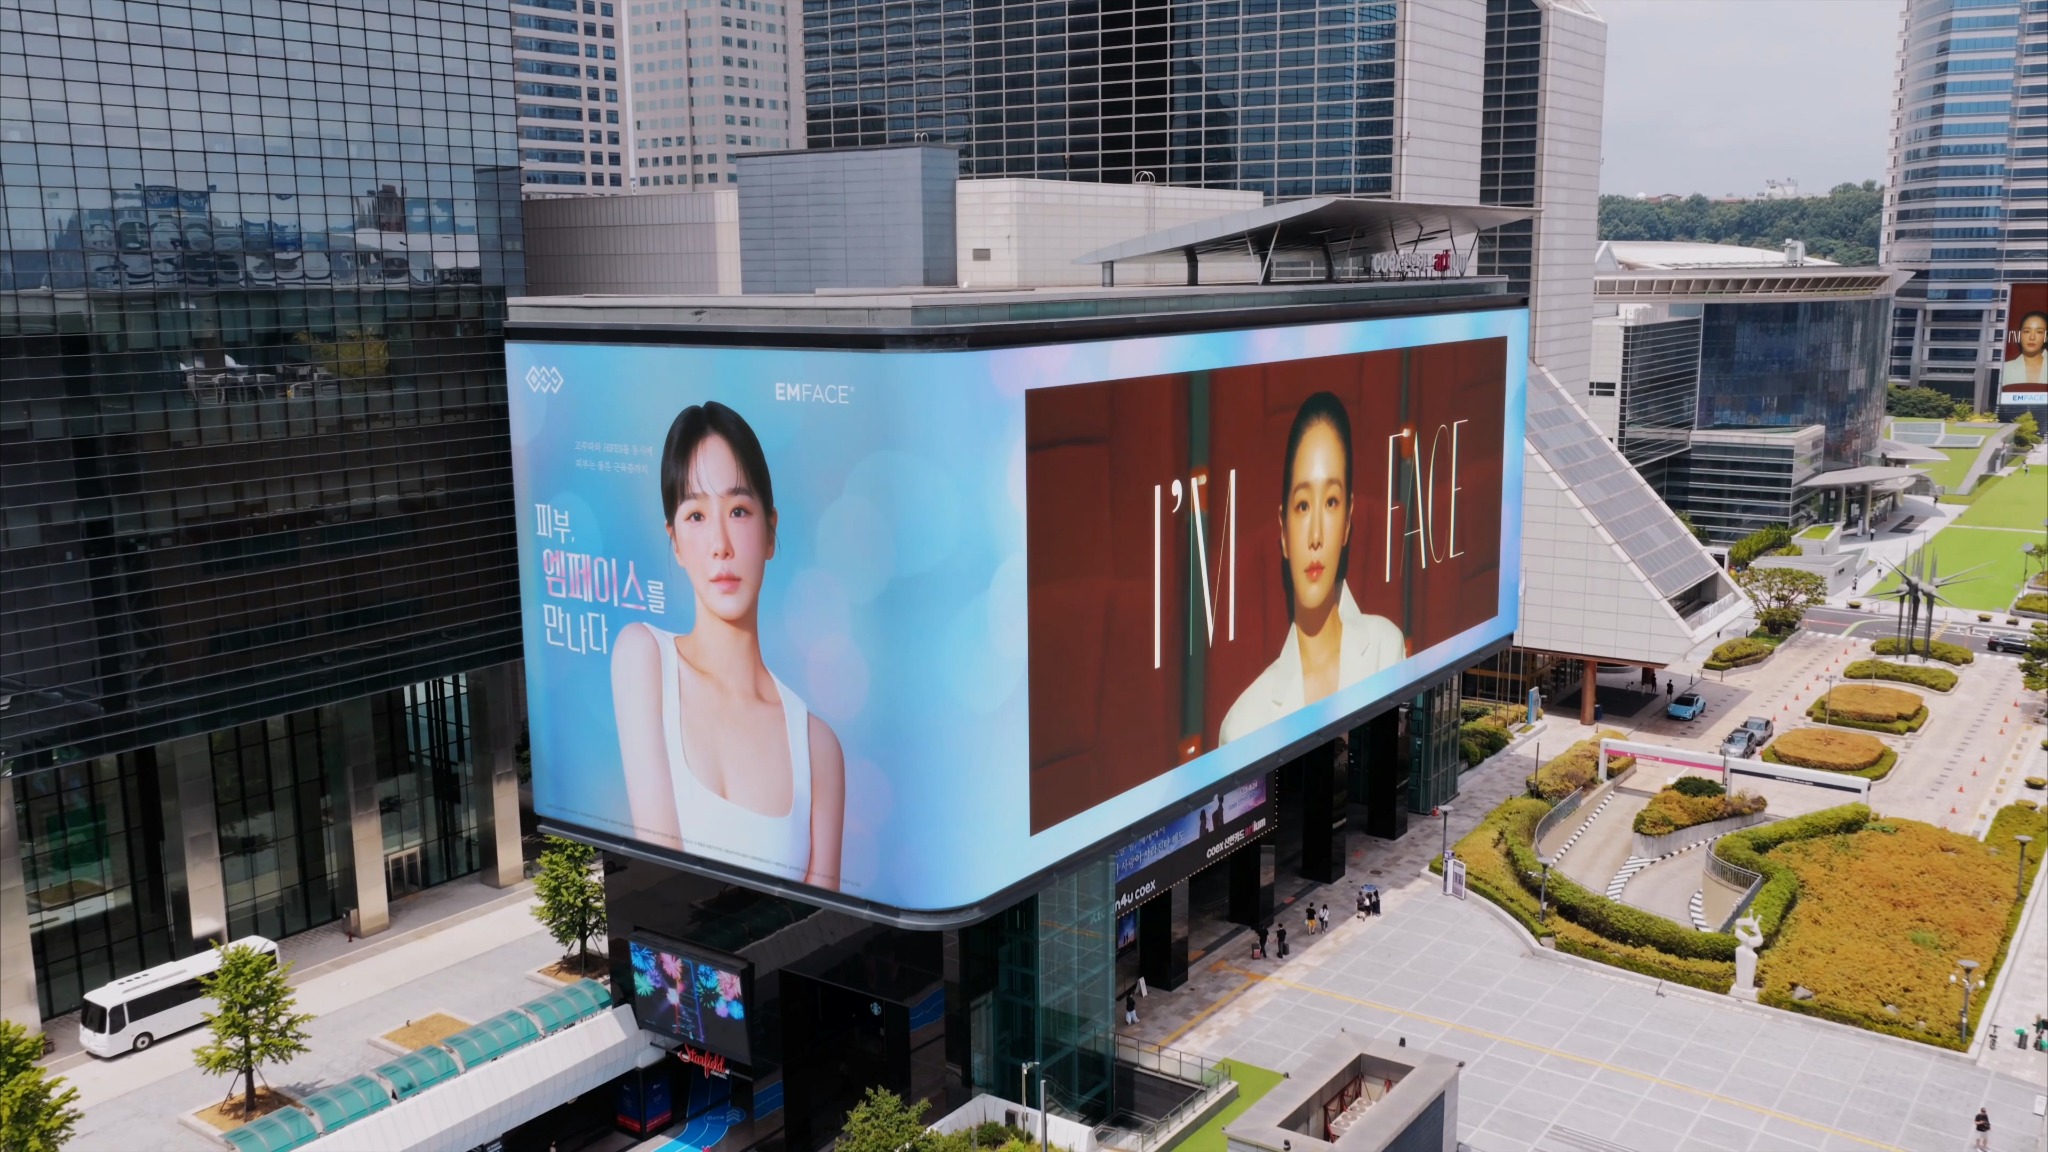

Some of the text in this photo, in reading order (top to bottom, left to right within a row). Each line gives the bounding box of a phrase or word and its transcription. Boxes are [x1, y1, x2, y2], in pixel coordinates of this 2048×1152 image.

[2012, 394, 2045, 402] EMFACE
[1385, 418, 1468, 584] FACE
[535, 503, 575, 544] 피부,
[542, 548, 666, 615] 엠페이스를
[542, 603, 609, 655] 만나다
[1207, 840, 1224, 858] coex
[1135, 879, 1156, 900] coex
[678, 1042, 726, 1079] Starfield
